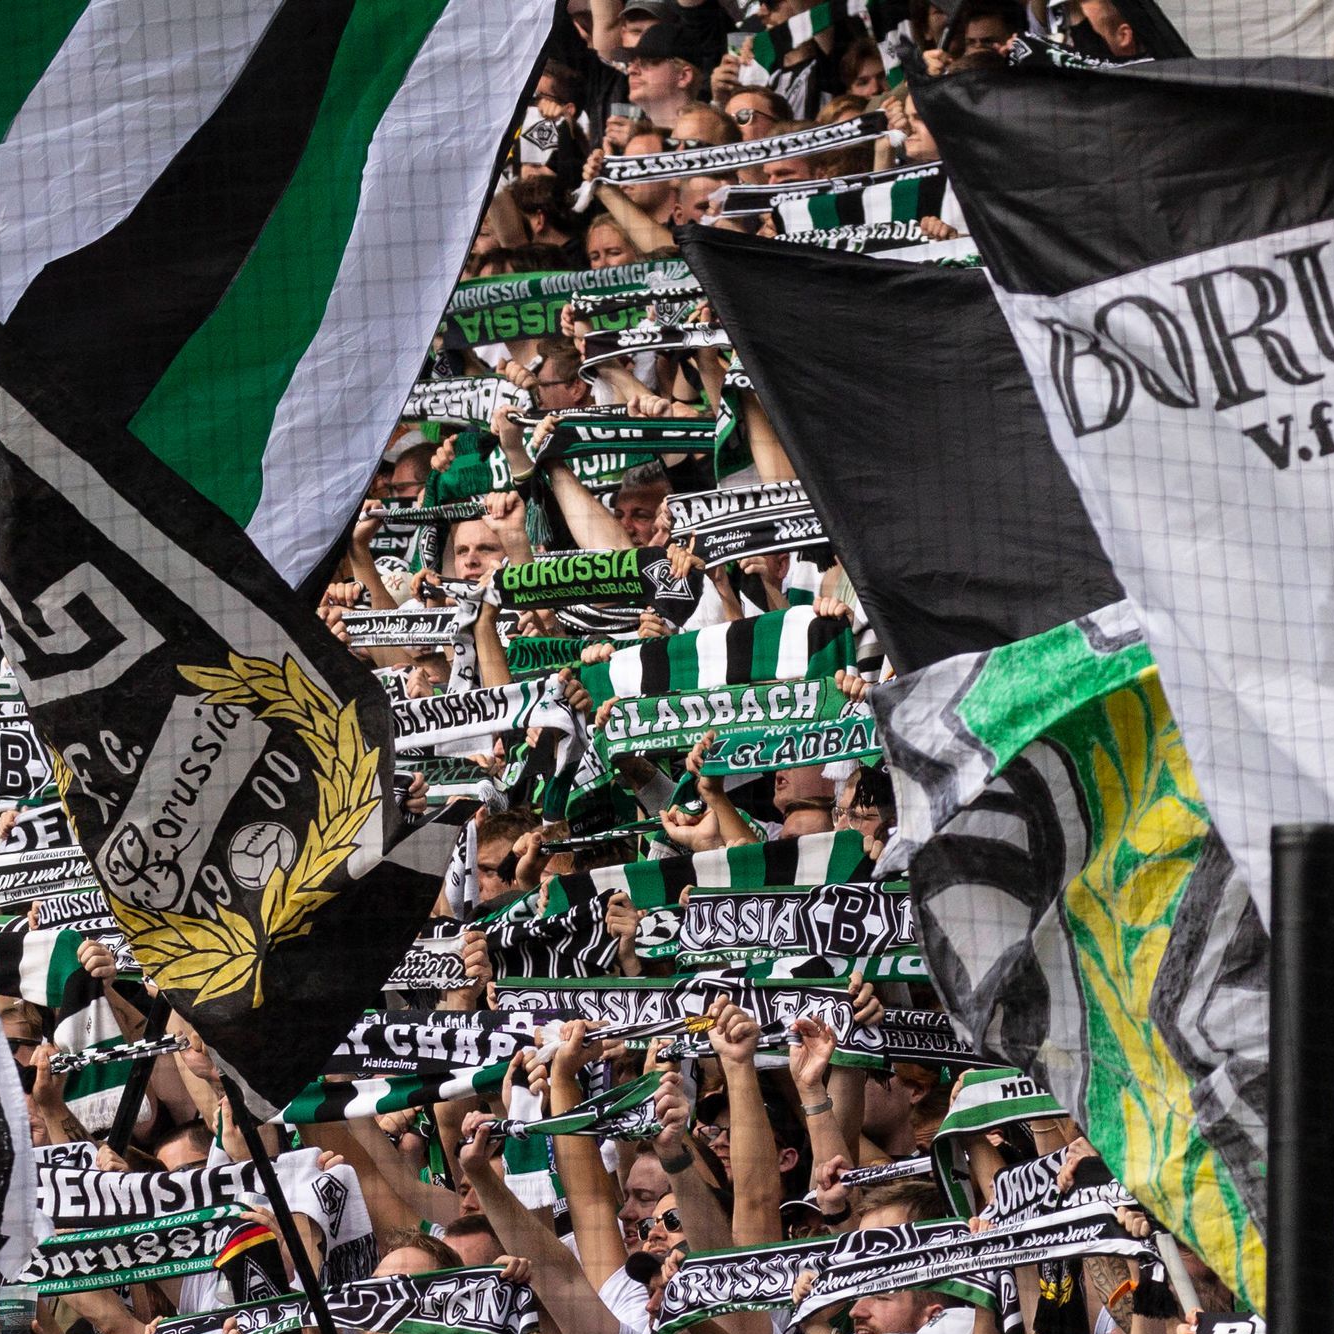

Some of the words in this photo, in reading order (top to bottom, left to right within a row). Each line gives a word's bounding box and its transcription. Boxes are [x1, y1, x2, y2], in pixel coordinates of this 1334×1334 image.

[604, 116, 863, 178] TRADITIONSVEREIN
[671, 479, 812, 528] RADITION
[703, 529, 752, 547] Tradition
[501, 550, 641, 591] BORUSSIA
[513, 578, 643, 604] MÖNCHENGLADBACH
[603, 682, 822, 741] GLADBACH
[607, 742, 628, 760] DIE
[632, 735, 681, 755] MACHT
[726, 730, 882, 769] GLADBA
[107, 702, 240, 911] Borussia
[361, 1056, 418, 1071] Waldsolms
[999, 1076, 1053, 1099] MÖN
[83, 1223, 118, 1240] NEVER
[122, 1220, 154, 1235] WALK
[156, 1211, 200, 1230] ALONE
[972, 1246, 1049, 1270] Mönchengladbach
[37, 1277, 71, 1293] INMAL
[74, 1273, 123, 1290] BORUSSIA
[133, 1265, 170, 1280] IMMER
